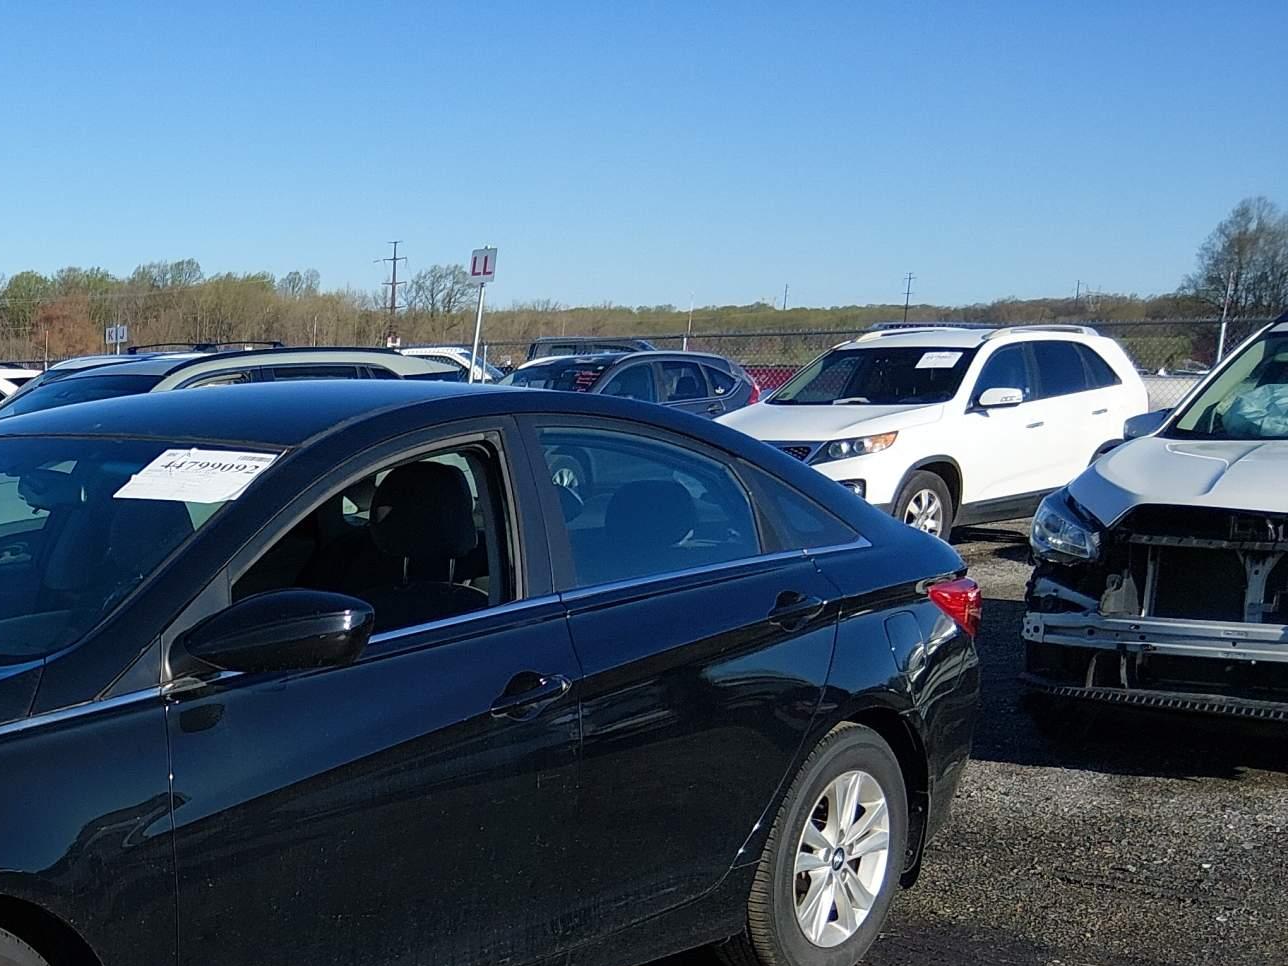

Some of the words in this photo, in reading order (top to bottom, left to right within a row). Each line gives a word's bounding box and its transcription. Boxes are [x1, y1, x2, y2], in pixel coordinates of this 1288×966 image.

[471, 255, 493, 276] LL
[108, 330, 114, 340] K
[119, 327, 125, 340] J
[160, 460, 260, 475] 44799092
